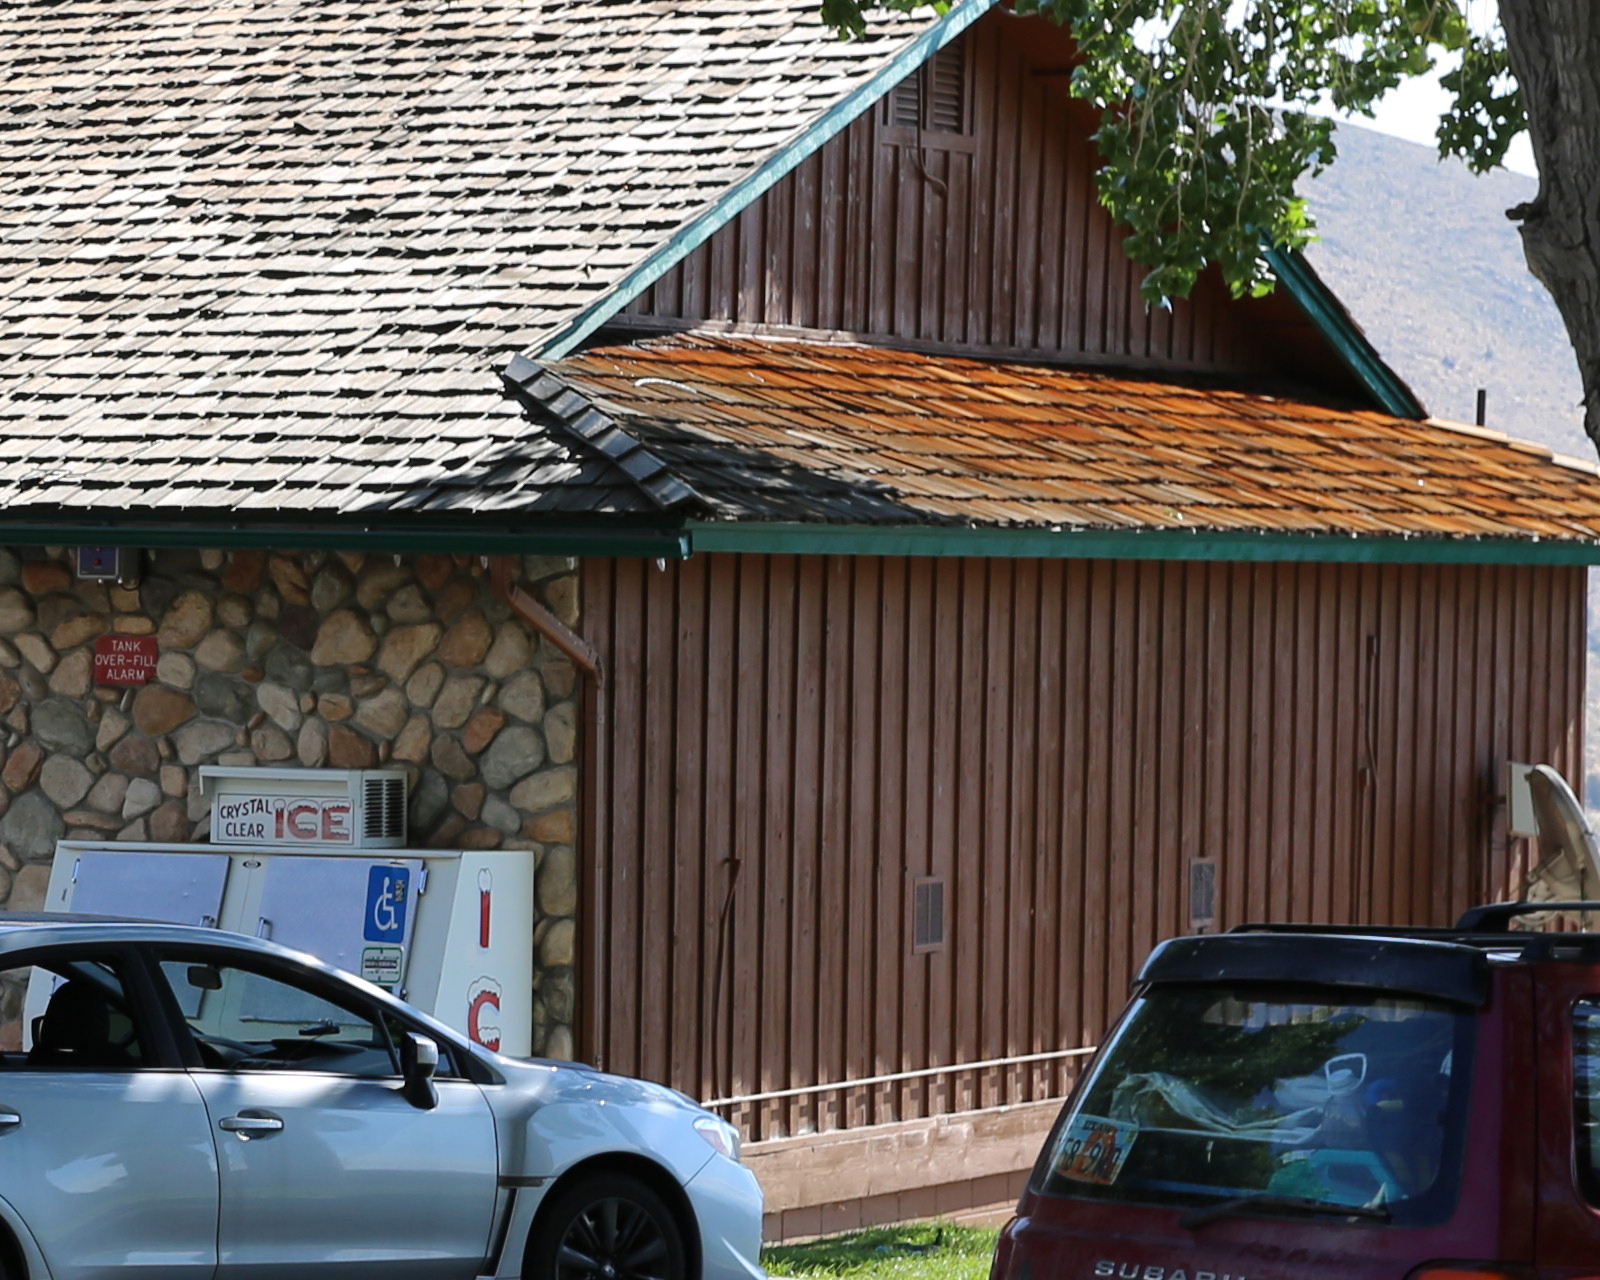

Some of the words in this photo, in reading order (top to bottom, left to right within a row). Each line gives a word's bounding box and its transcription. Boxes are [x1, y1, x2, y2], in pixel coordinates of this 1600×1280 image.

[112, 640, 141, 652] TANK
[95, 654, 156, 667] OVER-FILL
[107, 669, 145, 680] ALARM
[220, 798, 273, 819] CRYSTAL
[273, 799, 351, 840] ICE
[225, 822, 265, 839] CLEAR
